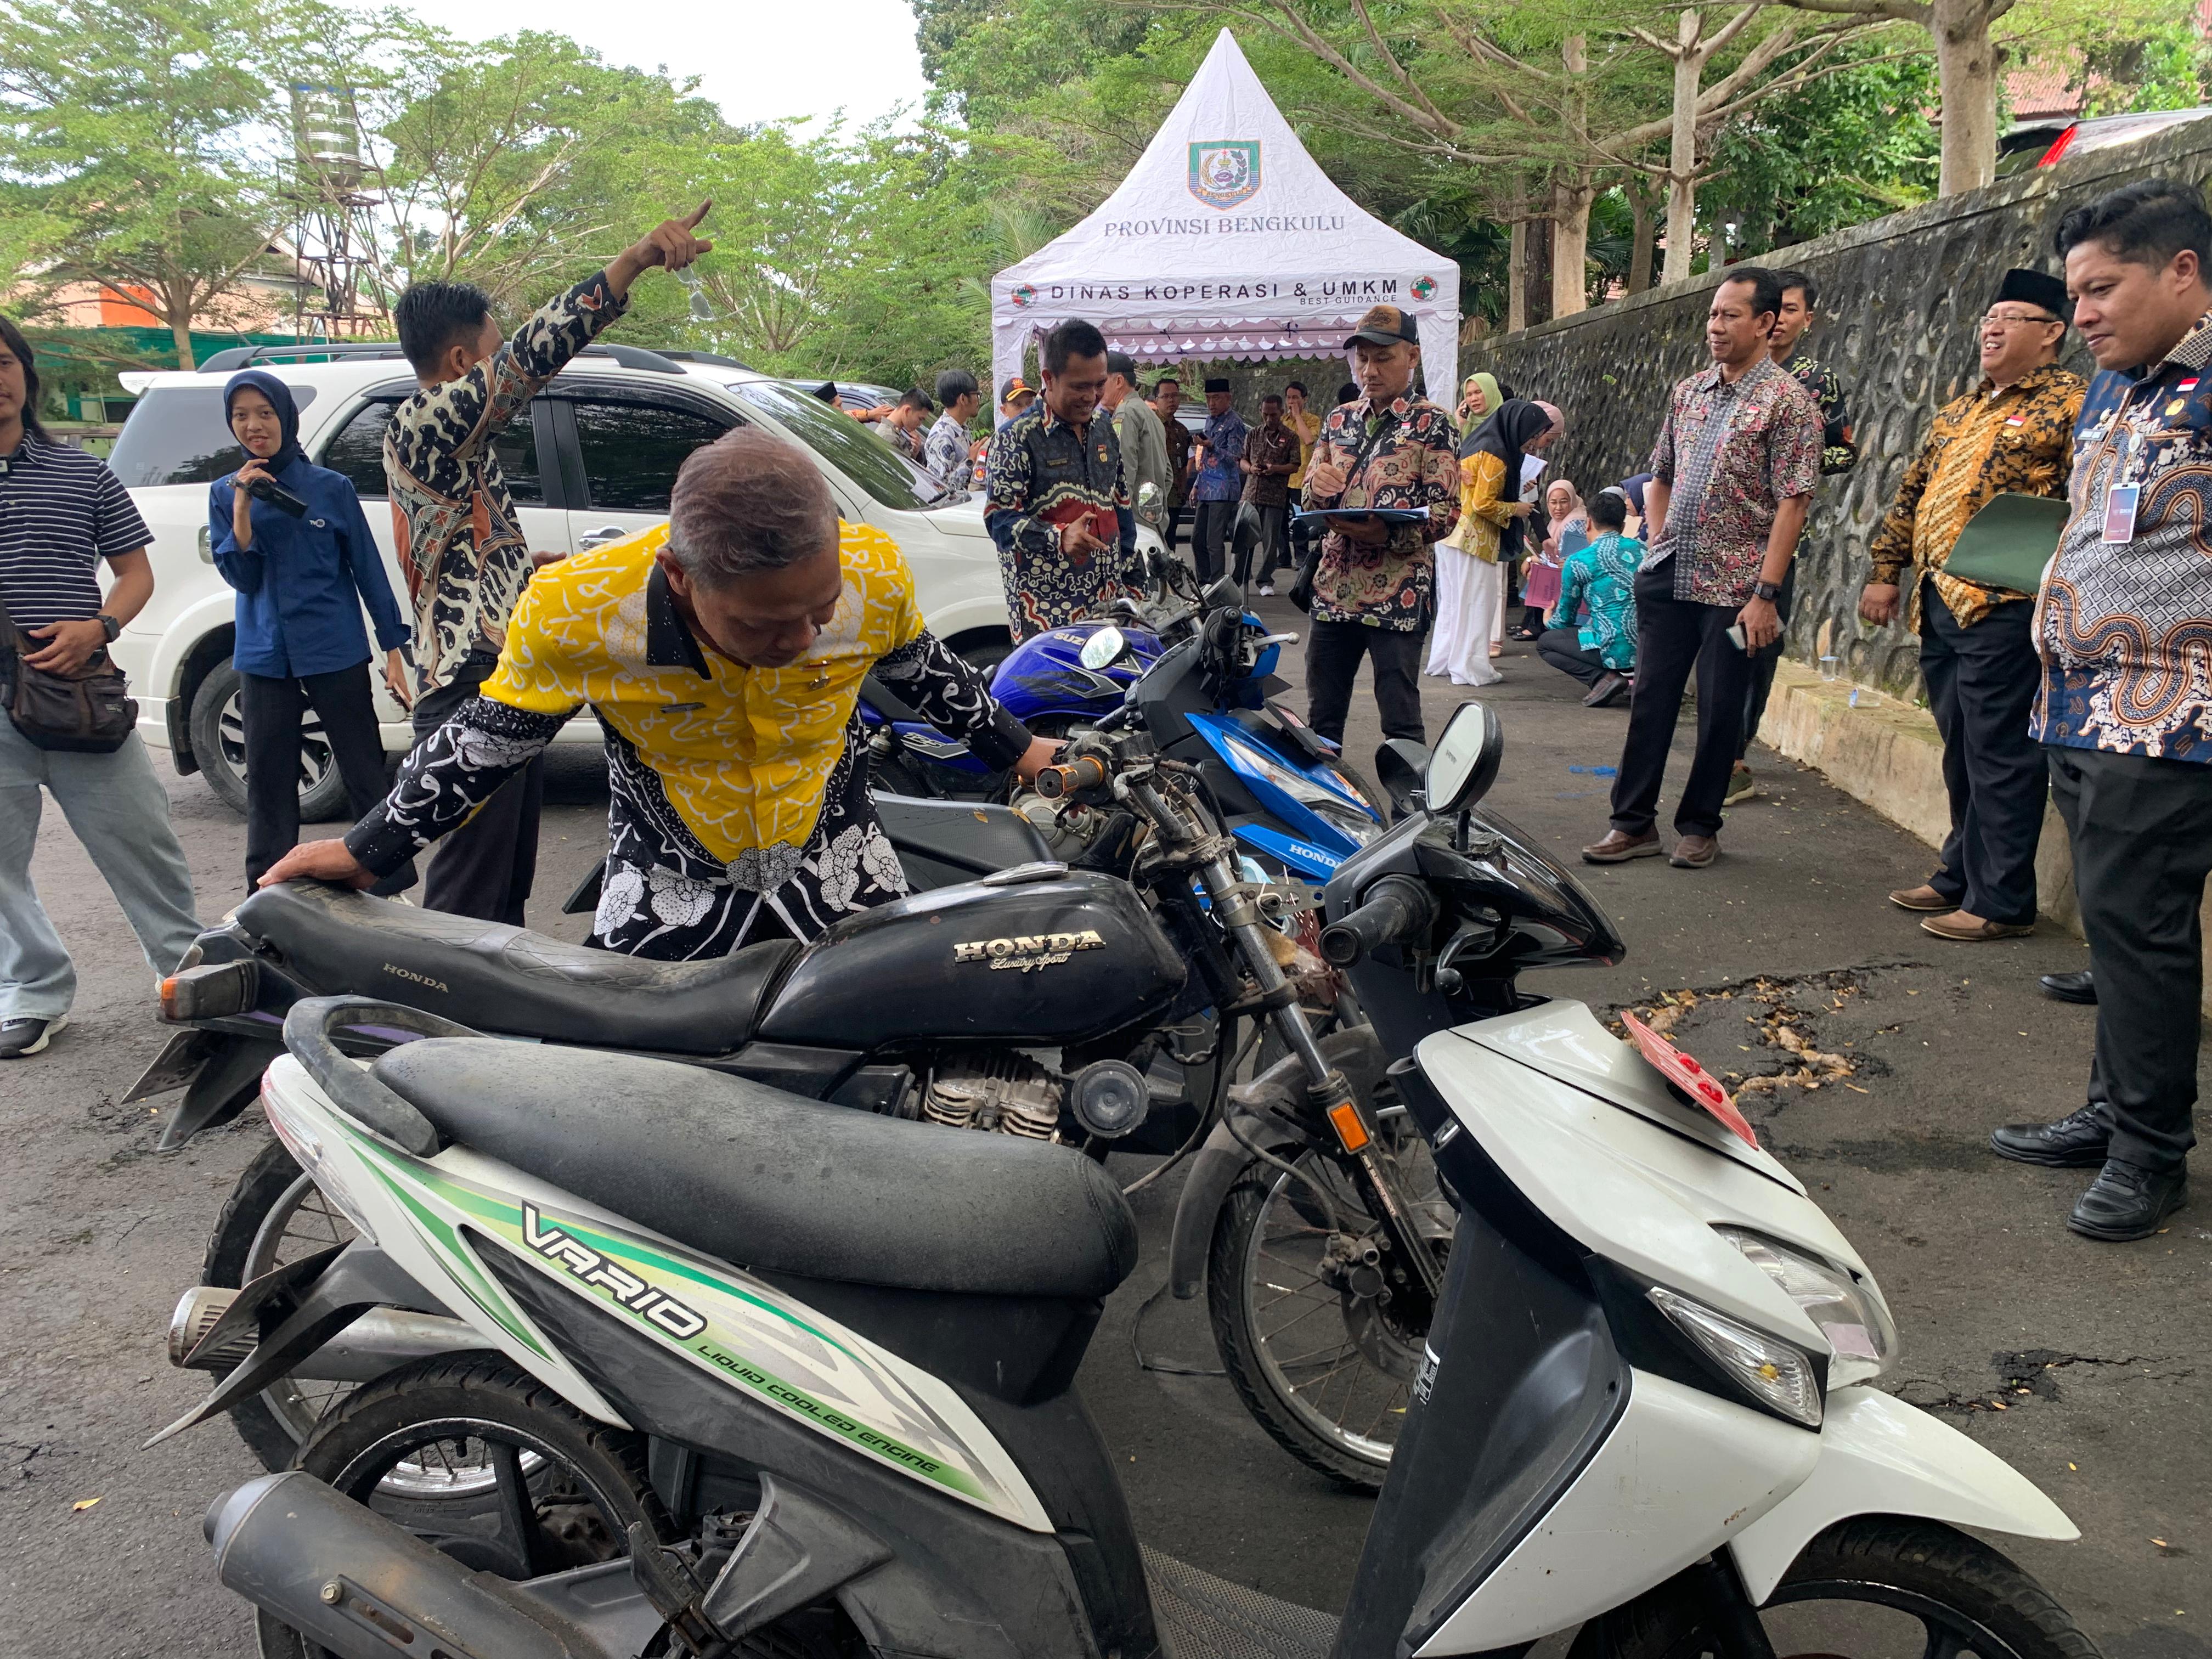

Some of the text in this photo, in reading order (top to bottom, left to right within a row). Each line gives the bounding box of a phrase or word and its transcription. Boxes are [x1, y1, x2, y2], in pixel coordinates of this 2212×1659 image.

[1104, 216, 1345, 236] PROVINSI BENGKULU
[1051, 285, 1130, 299] DINAS
[1145, 283, 1277, 300] KOPERASI
[1294, 283, 1307, 297] &
[1323, 280, 1397, 296] UMKM
[1335, 295, 1397, 304] GUIDANCE
[1053, 632, 1085, 646] SUZ
[1289, 844, 1342, 869] HOND
[954, 930, 1106, 963] HONDA
[990, 952, 1071, 973] Luxury Sport
[383, 963, 449, 993] HONDA
[1362, 1155, 1372, 1167] AIR
[522, 1201, 707, 1339] VARIO
[697, 1345, 940, 1473] LIQUID COOLED ENGINE
